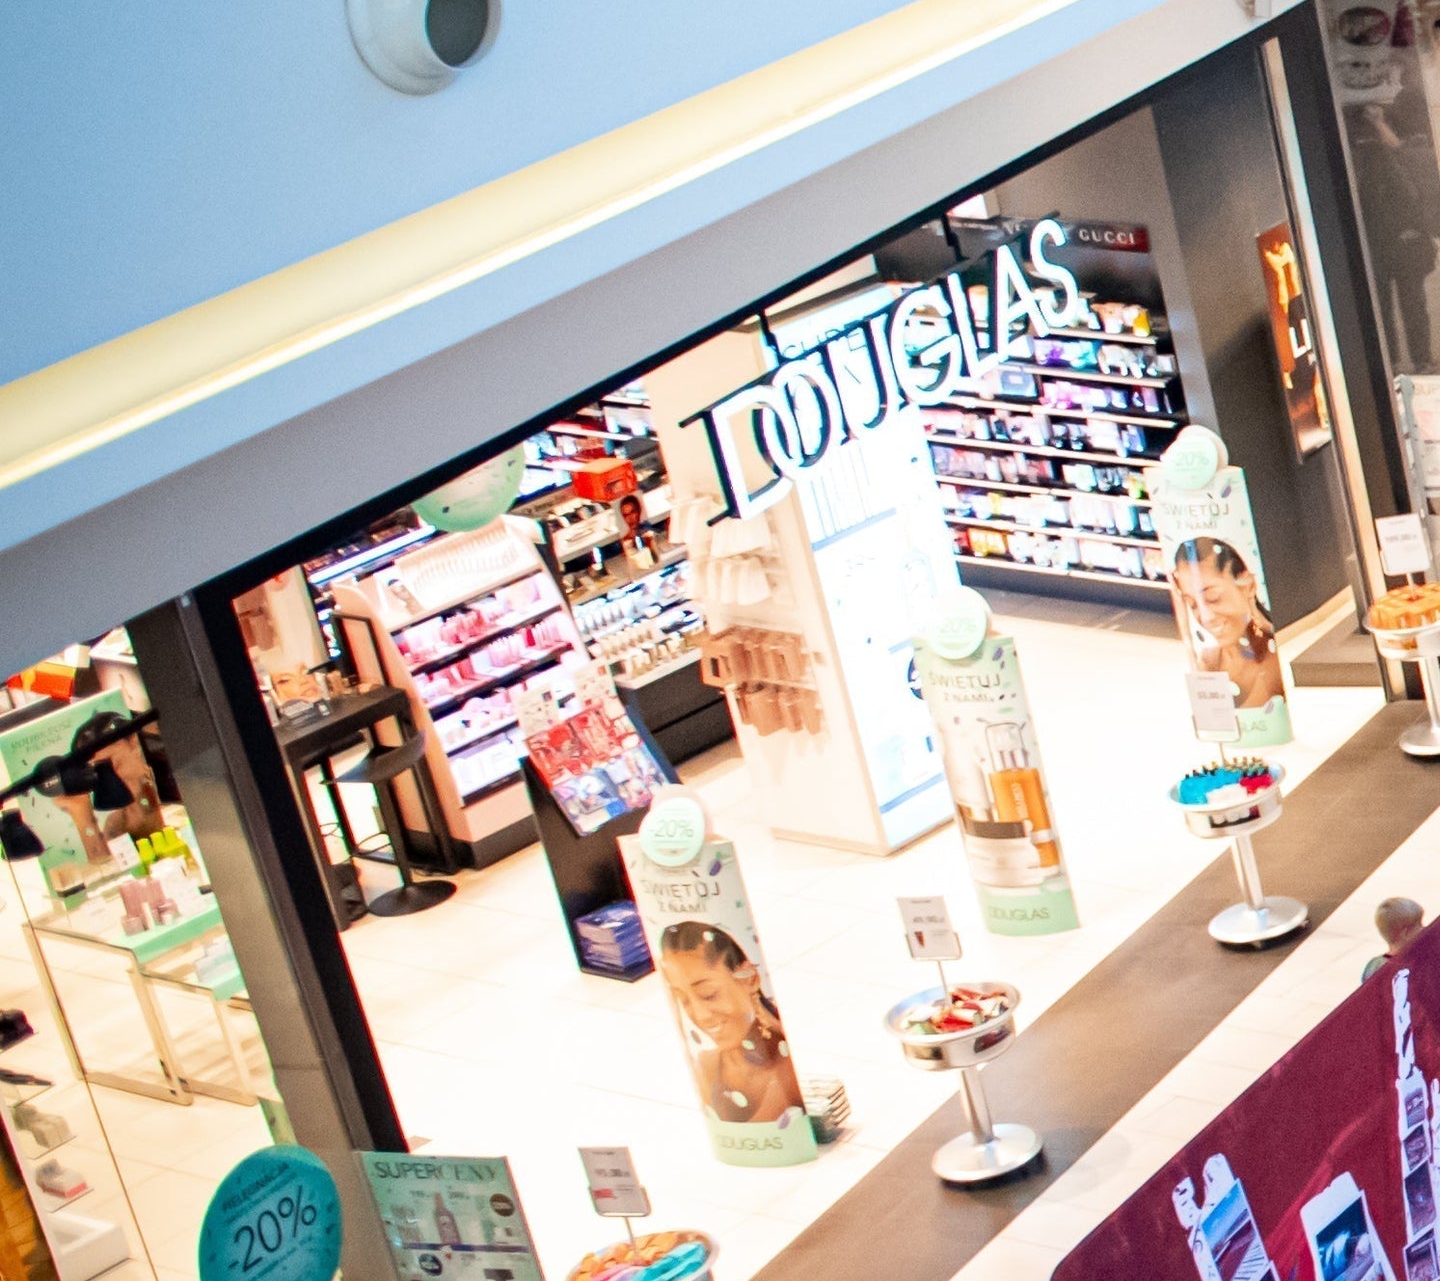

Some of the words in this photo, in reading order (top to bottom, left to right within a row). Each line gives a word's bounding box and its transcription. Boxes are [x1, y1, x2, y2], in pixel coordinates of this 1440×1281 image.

[1079, 228, 1137, 246] GUCCI
[678, 212, 1085, 526] DOUGLAS
[374, 1159, 506, 1182] SUPERCENY
[228, 1185, 318, 1274] -20%
